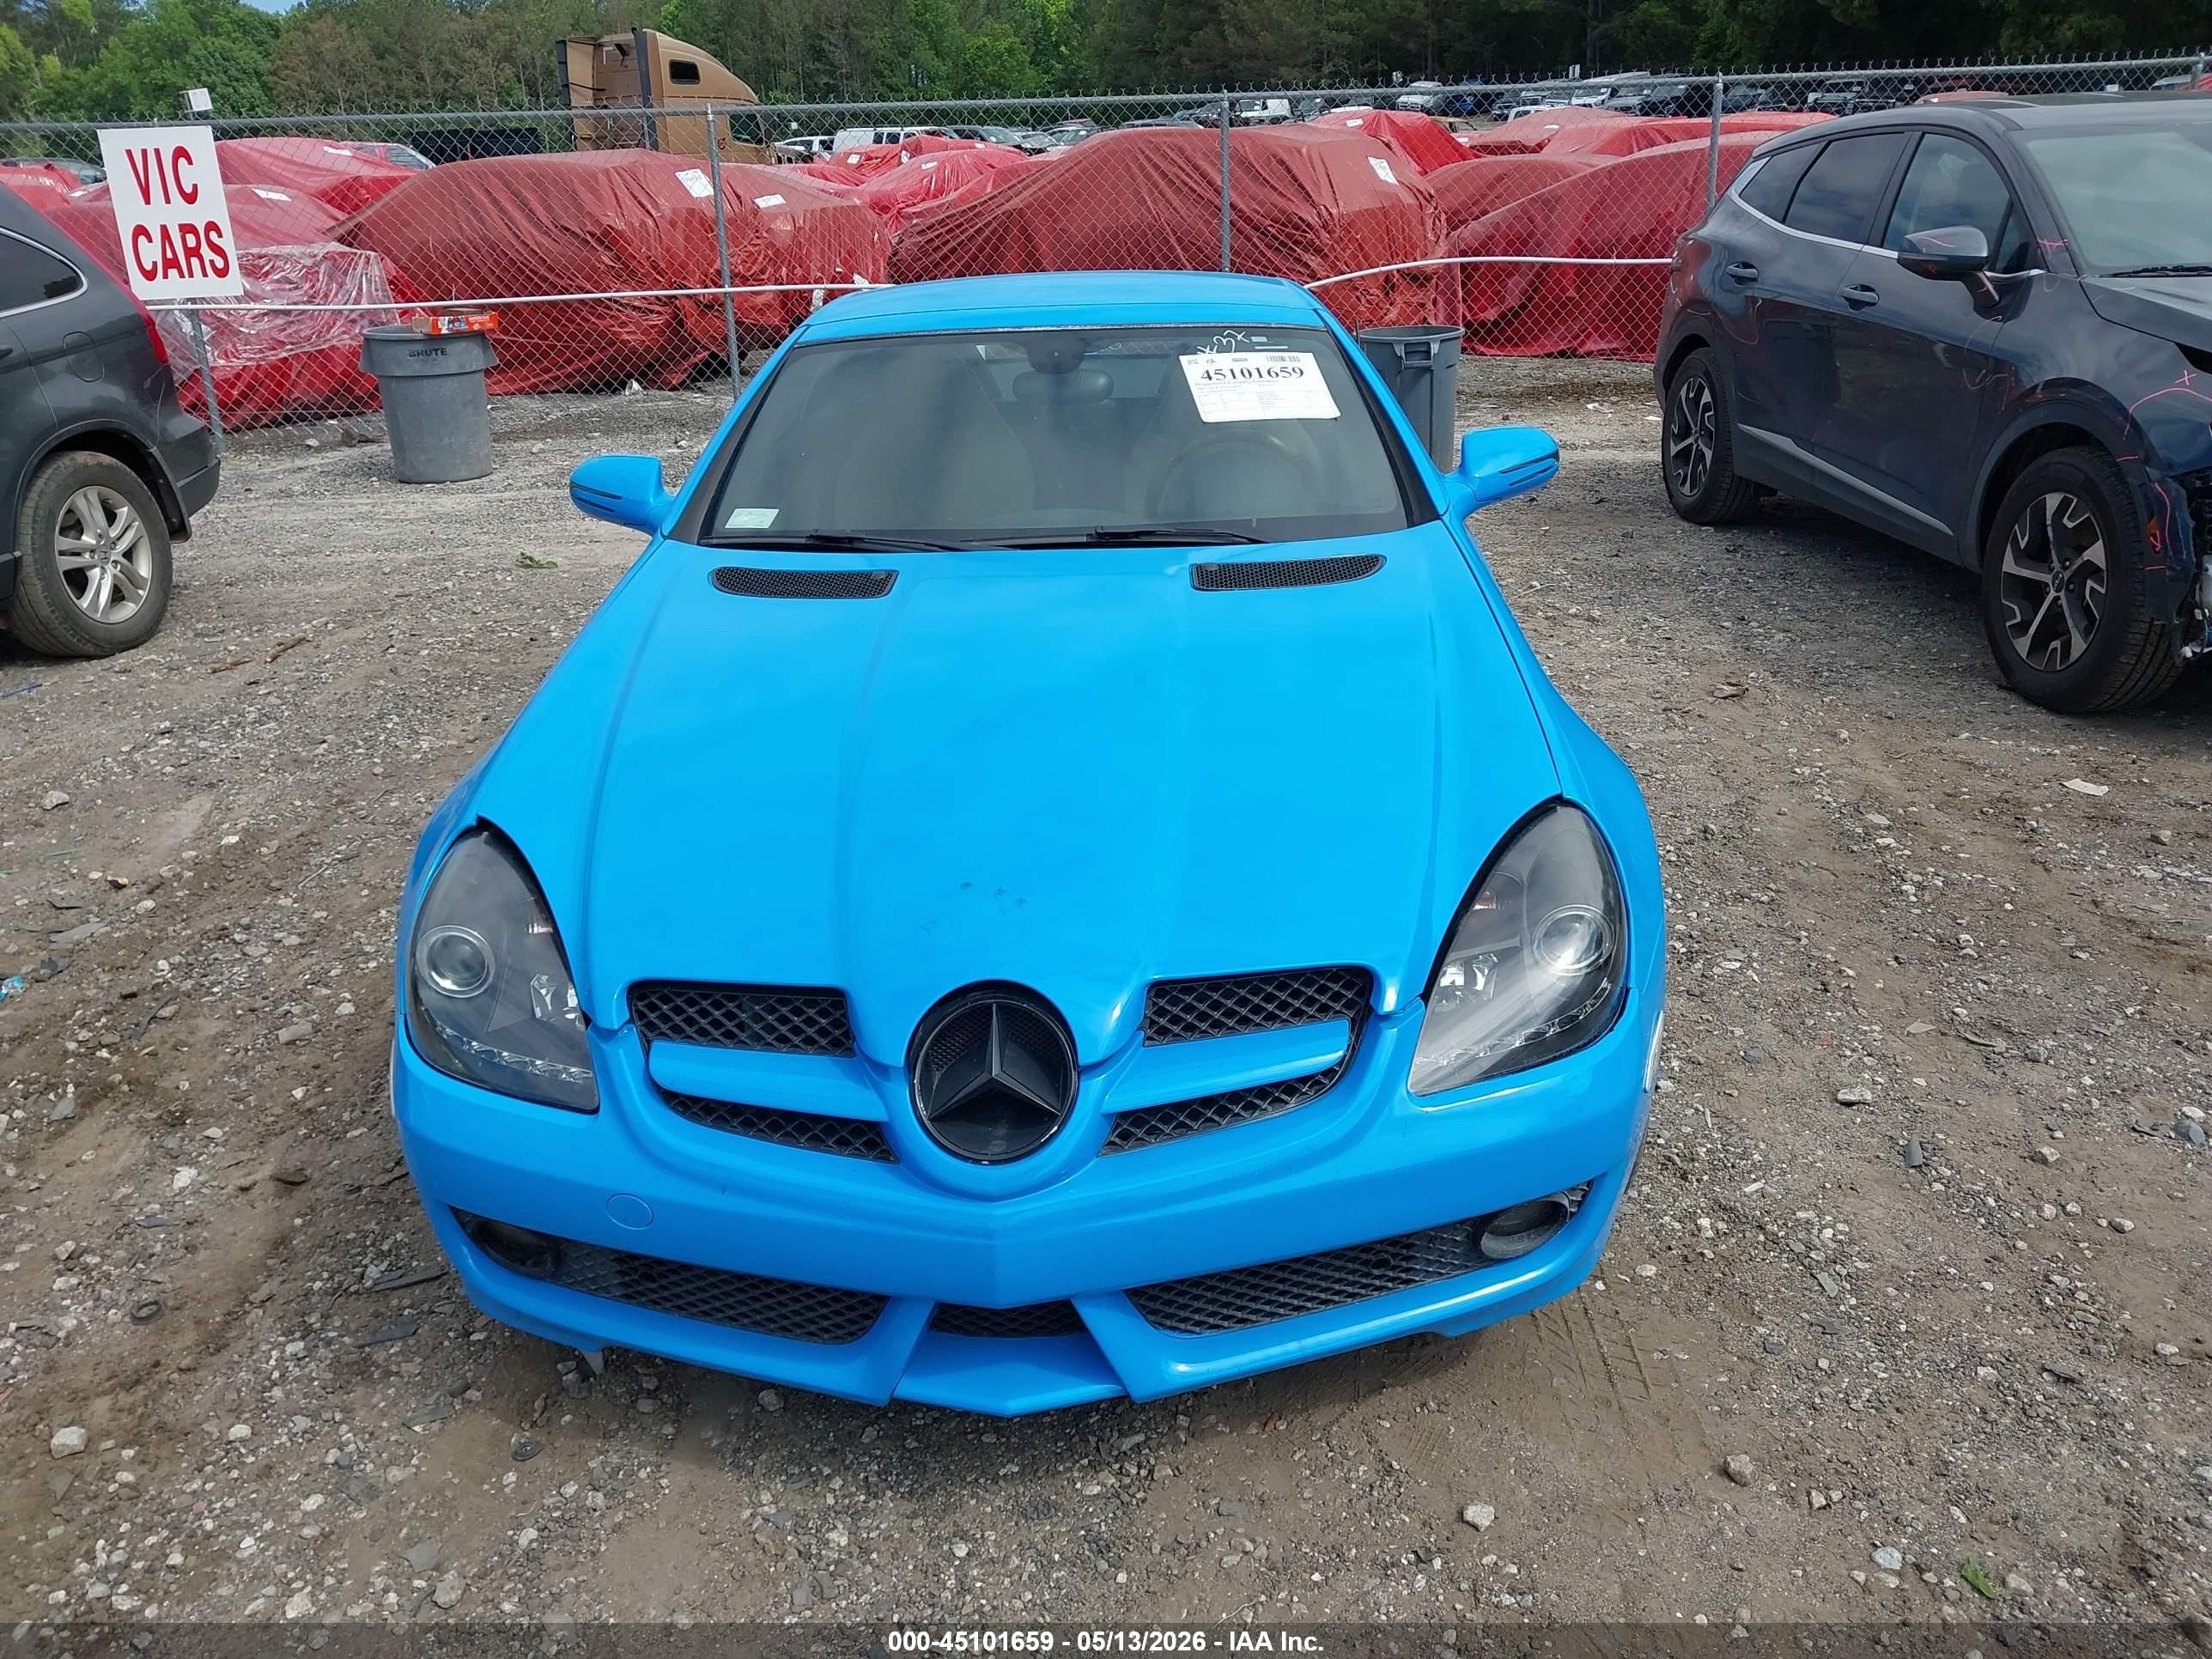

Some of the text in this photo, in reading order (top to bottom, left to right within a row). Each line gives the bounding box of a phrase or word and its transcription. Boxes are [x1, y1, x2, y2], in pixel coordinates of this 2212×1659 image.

[125, 146, 198, 205] VIC
[131, 221, 230, 282] CARS
[408, 347, 447, 358] BRUTE
[1200, 366, 1304, 381] 45101659
